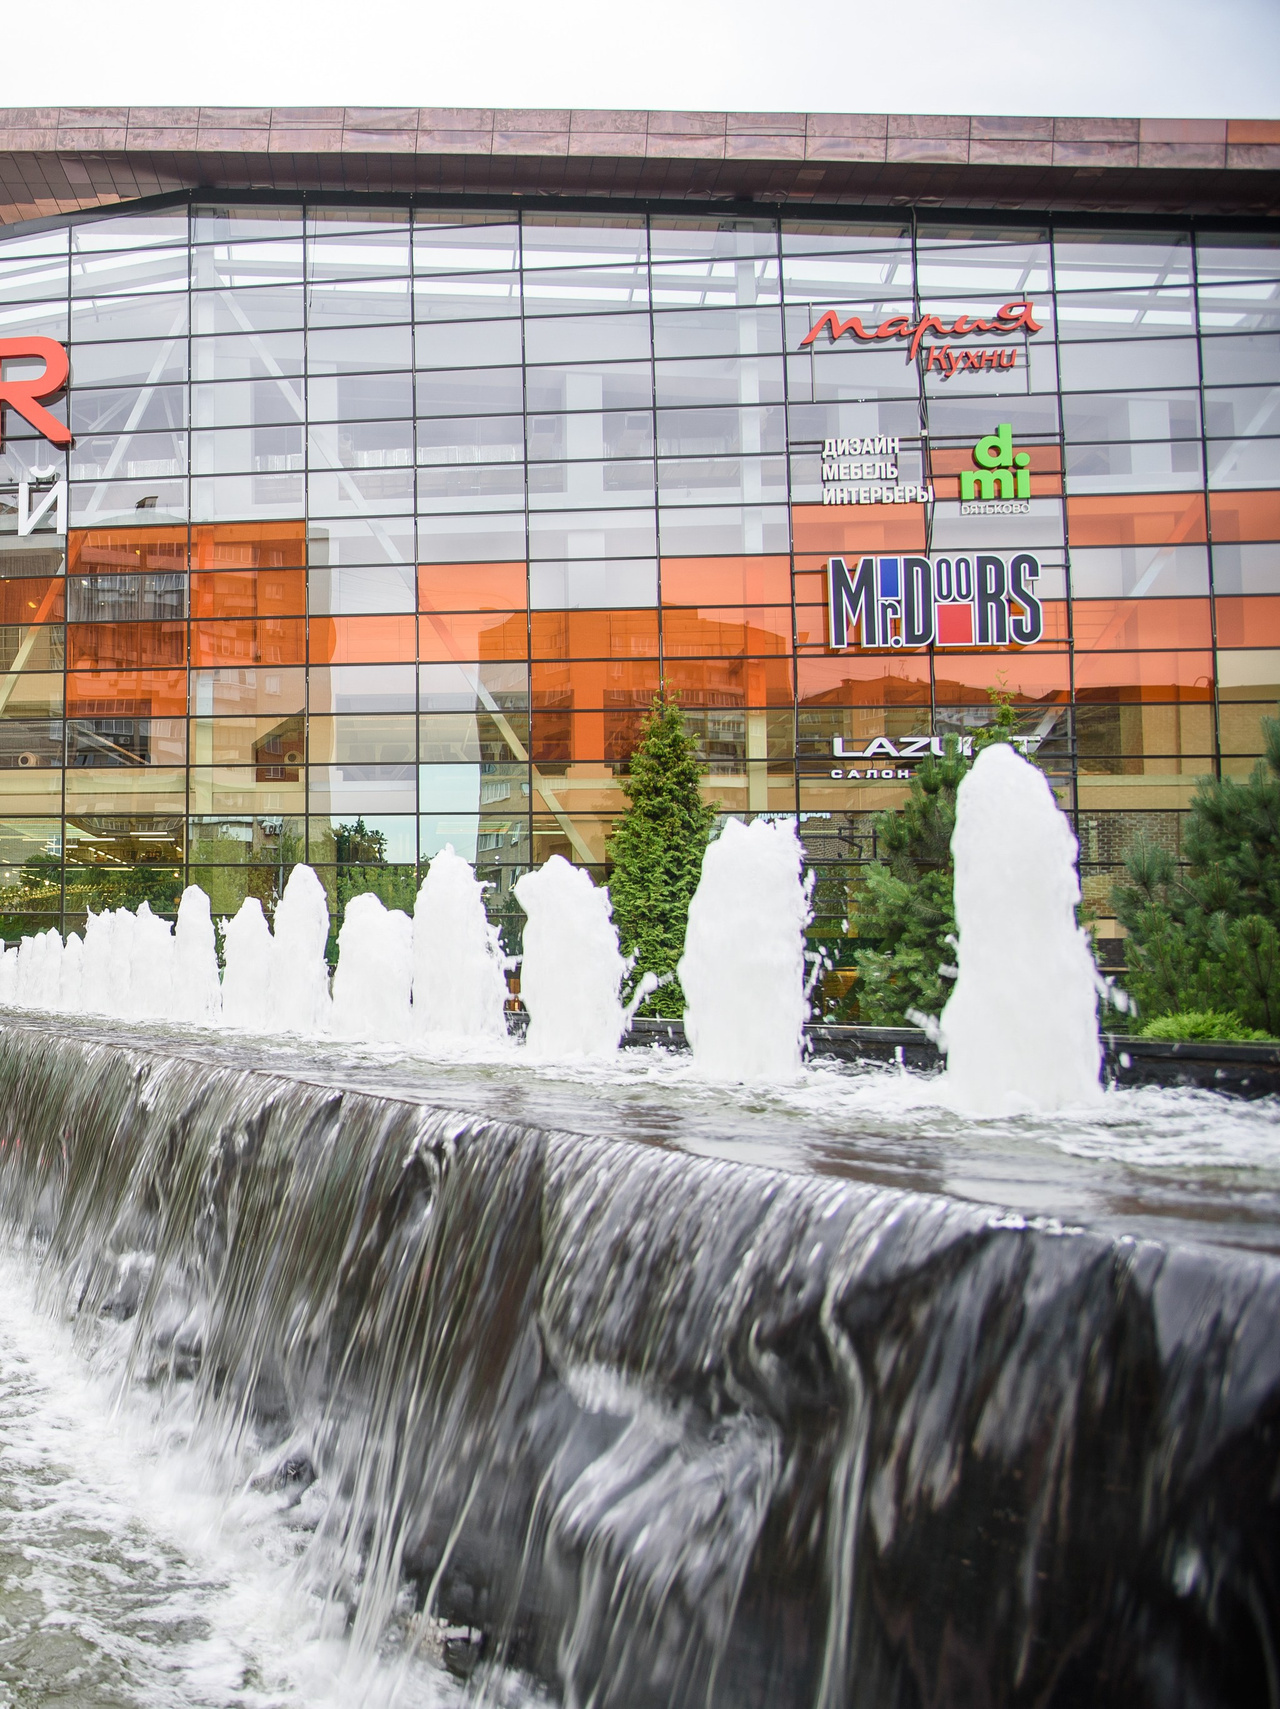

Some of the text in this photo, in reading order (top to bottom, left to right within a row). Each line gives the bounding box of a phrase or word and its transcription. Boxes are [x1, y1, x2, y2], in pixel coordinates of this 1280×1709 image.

[926, 344, 1018, 378] Кухни
[822, 434, 900, 459] ДИЗАЙН
[822, 462, 899, 482] МЕБЕЛЬ
[822, 485, 934, 506] ИНТЕРЬЕРЫ
[833, 736, 1041, 758] LAZUT
[830, 769, 910, 780] САЛОН
